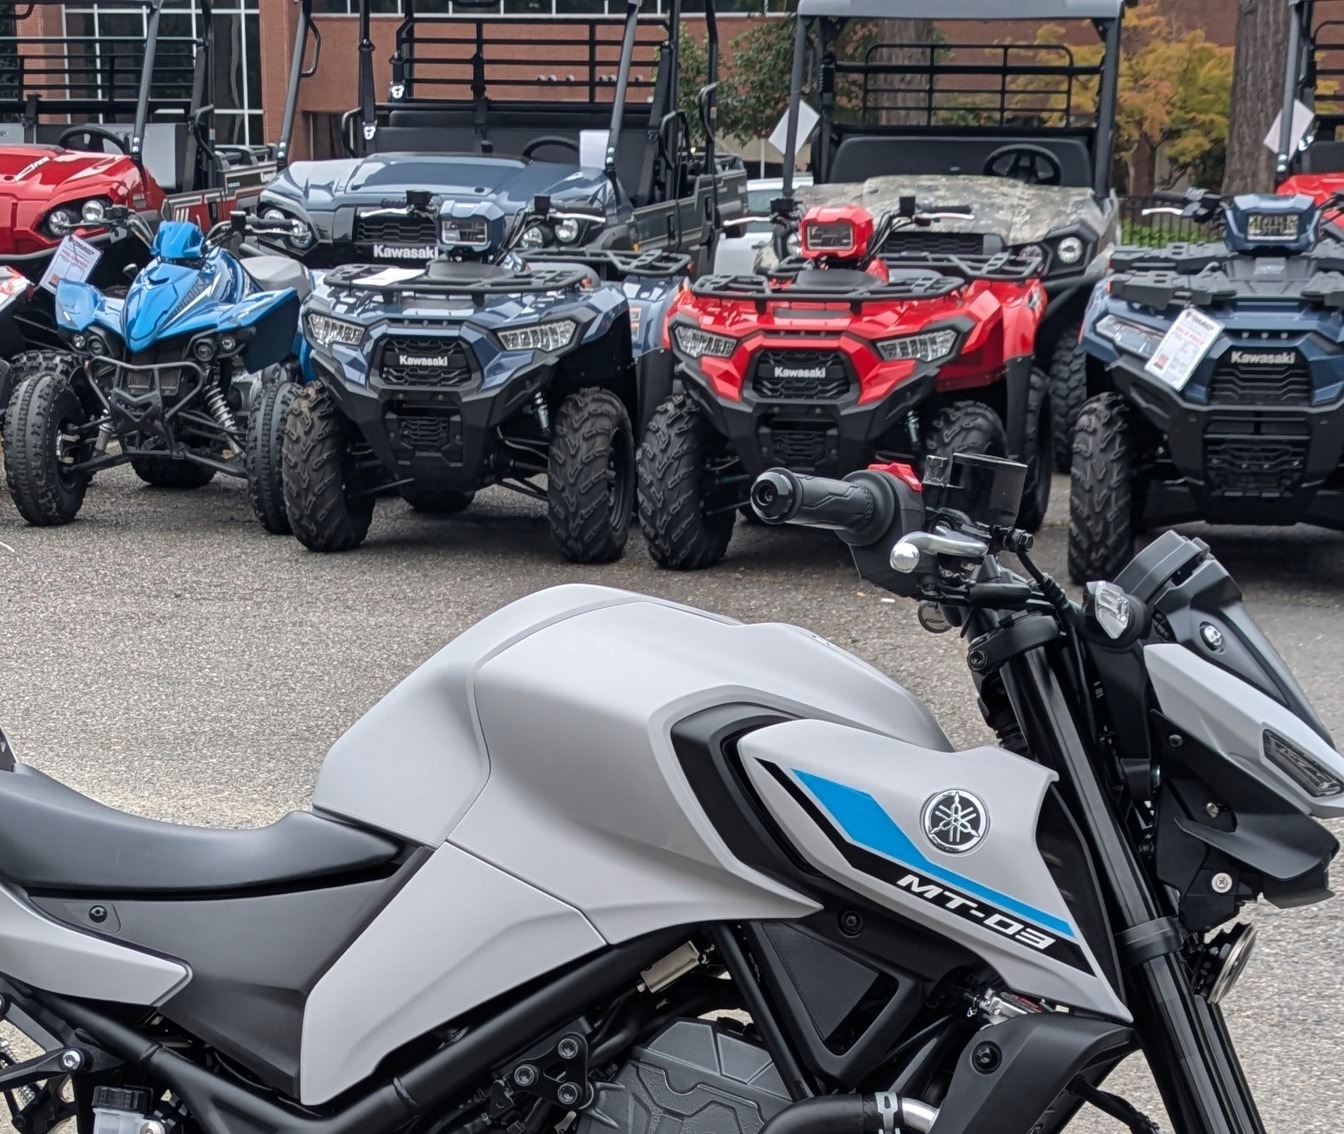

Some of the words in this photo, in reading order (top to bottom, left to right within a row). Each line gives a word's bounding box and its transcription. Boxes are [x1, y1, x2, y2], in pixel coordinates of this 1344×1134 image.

[373, 244, 439, 259] Kawasaki
[399, 355, 448, 367] Kawasaki
[1231, 351, 1296, 364] Kawasaki
[774, 366, 826, 378] Kawasaki
[896, 874, 1056, 950] MT-03
